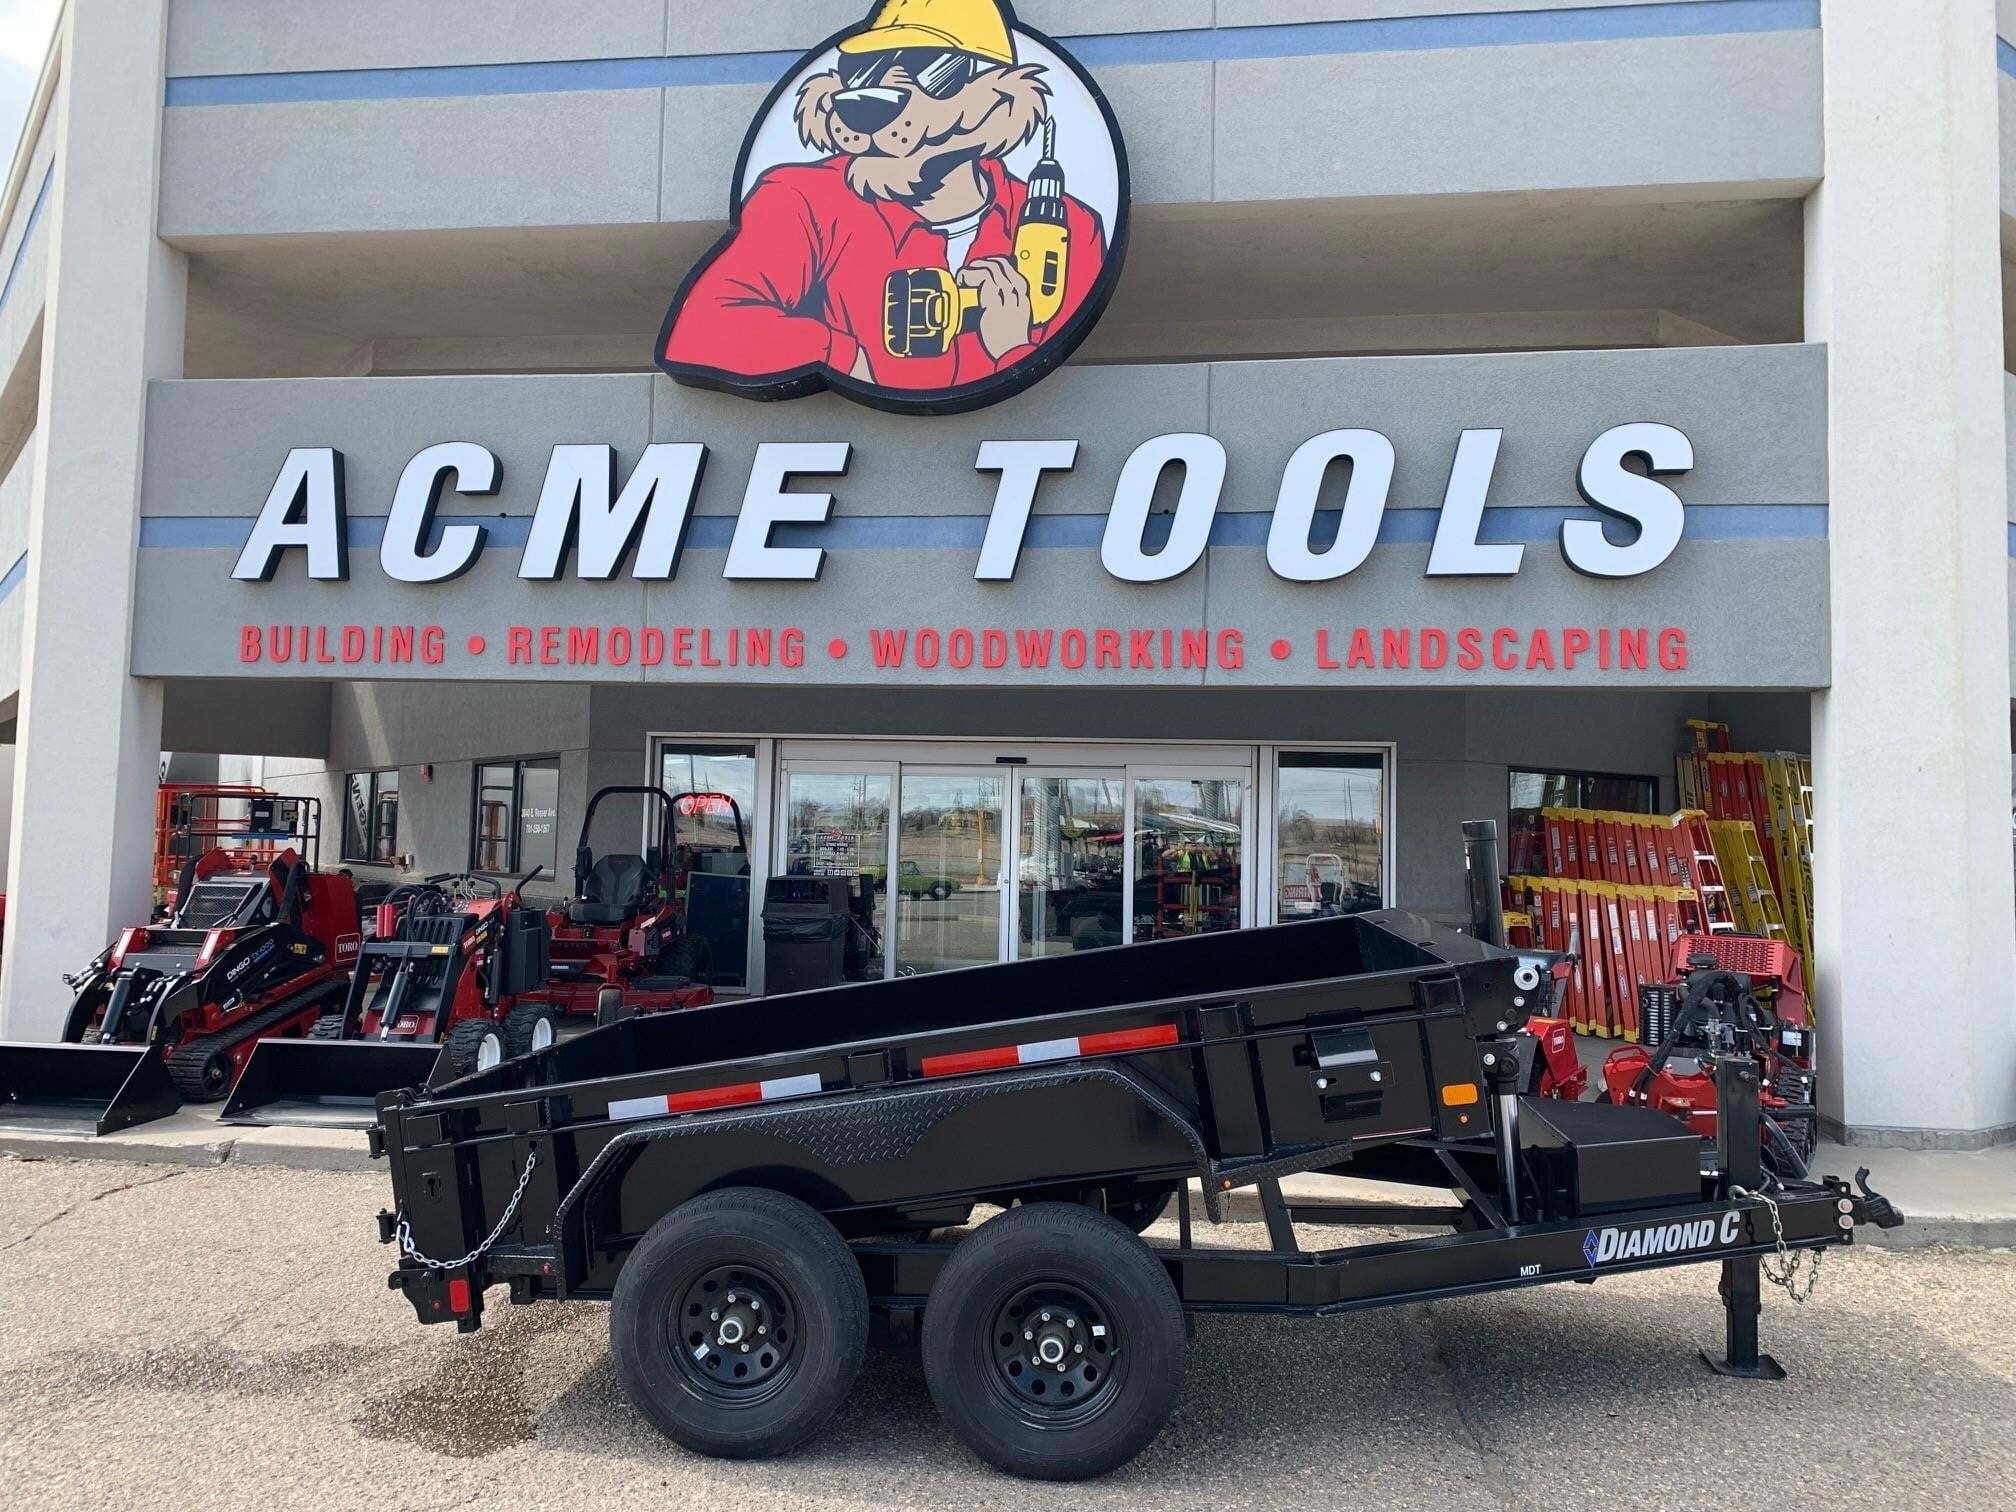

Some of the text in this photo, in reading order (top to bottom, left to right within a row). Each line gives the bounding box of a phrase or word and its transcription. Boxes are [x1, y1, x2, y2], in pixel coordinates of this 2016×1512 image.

[229, 421, 1695, 584] ACME TOOLS
[240, 625, 1690, 671] BUILDING REMODELING WOODWORKING LANDSCAPING
[681, 795, 732, 815] OPEN
[338, 941, 358, 953] TORO
[226, 957, 250, 980] DINGO
[397, 1019, 415, 1029] ORO
[1596, 1211, 1740, 1263] DIAMOND C
[1520, 1264, 1542, 1277] MDT
